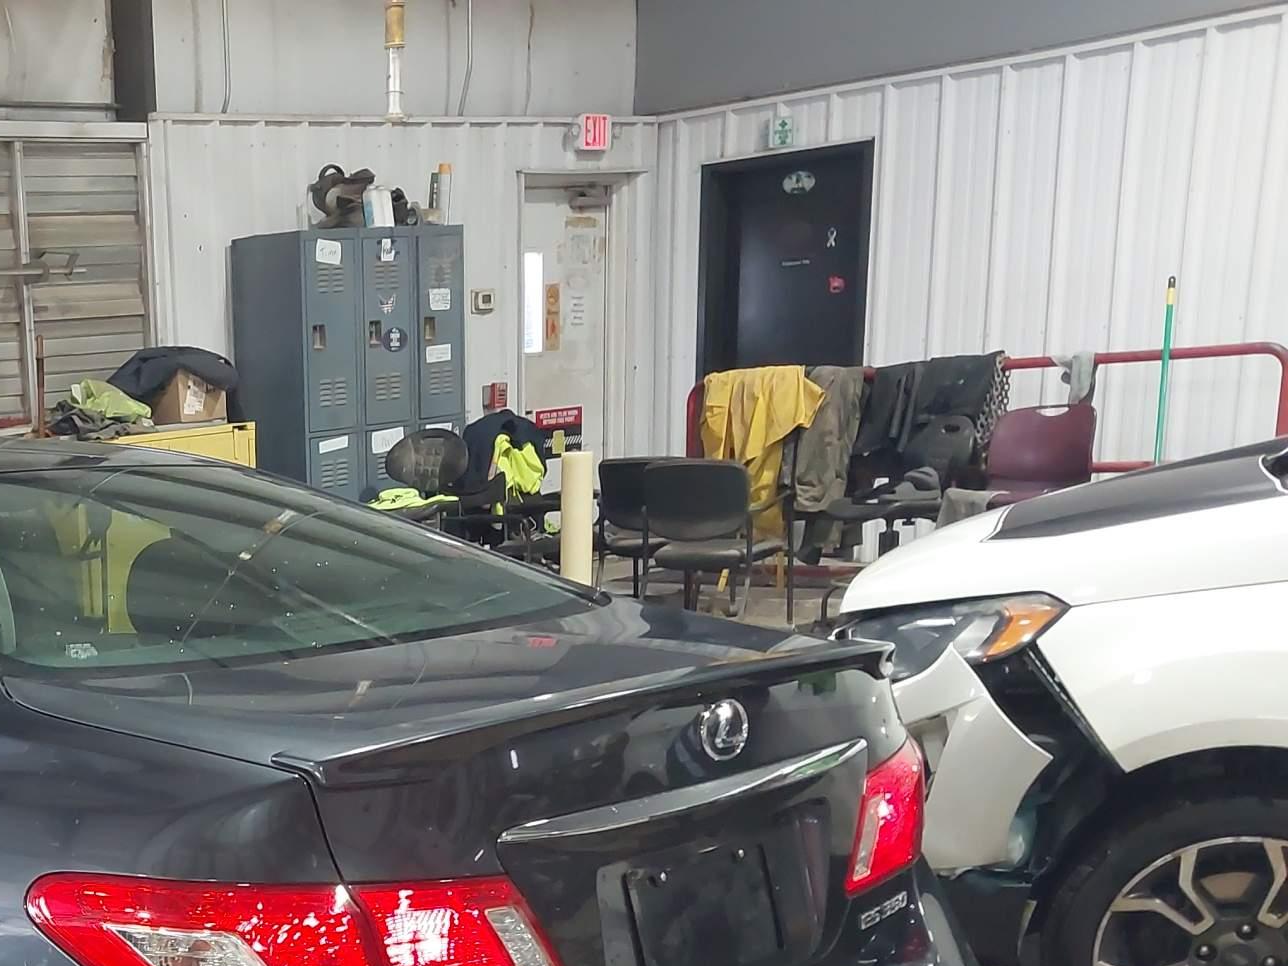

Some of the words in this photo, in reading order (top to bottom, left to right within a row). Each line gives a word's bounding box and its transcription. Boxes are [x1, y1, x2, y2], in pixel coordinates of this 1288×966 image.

[585, 116, 608, 146] EXIT
[861, 906, 881, 930] ES
[882, 891, 907, 919] 350
